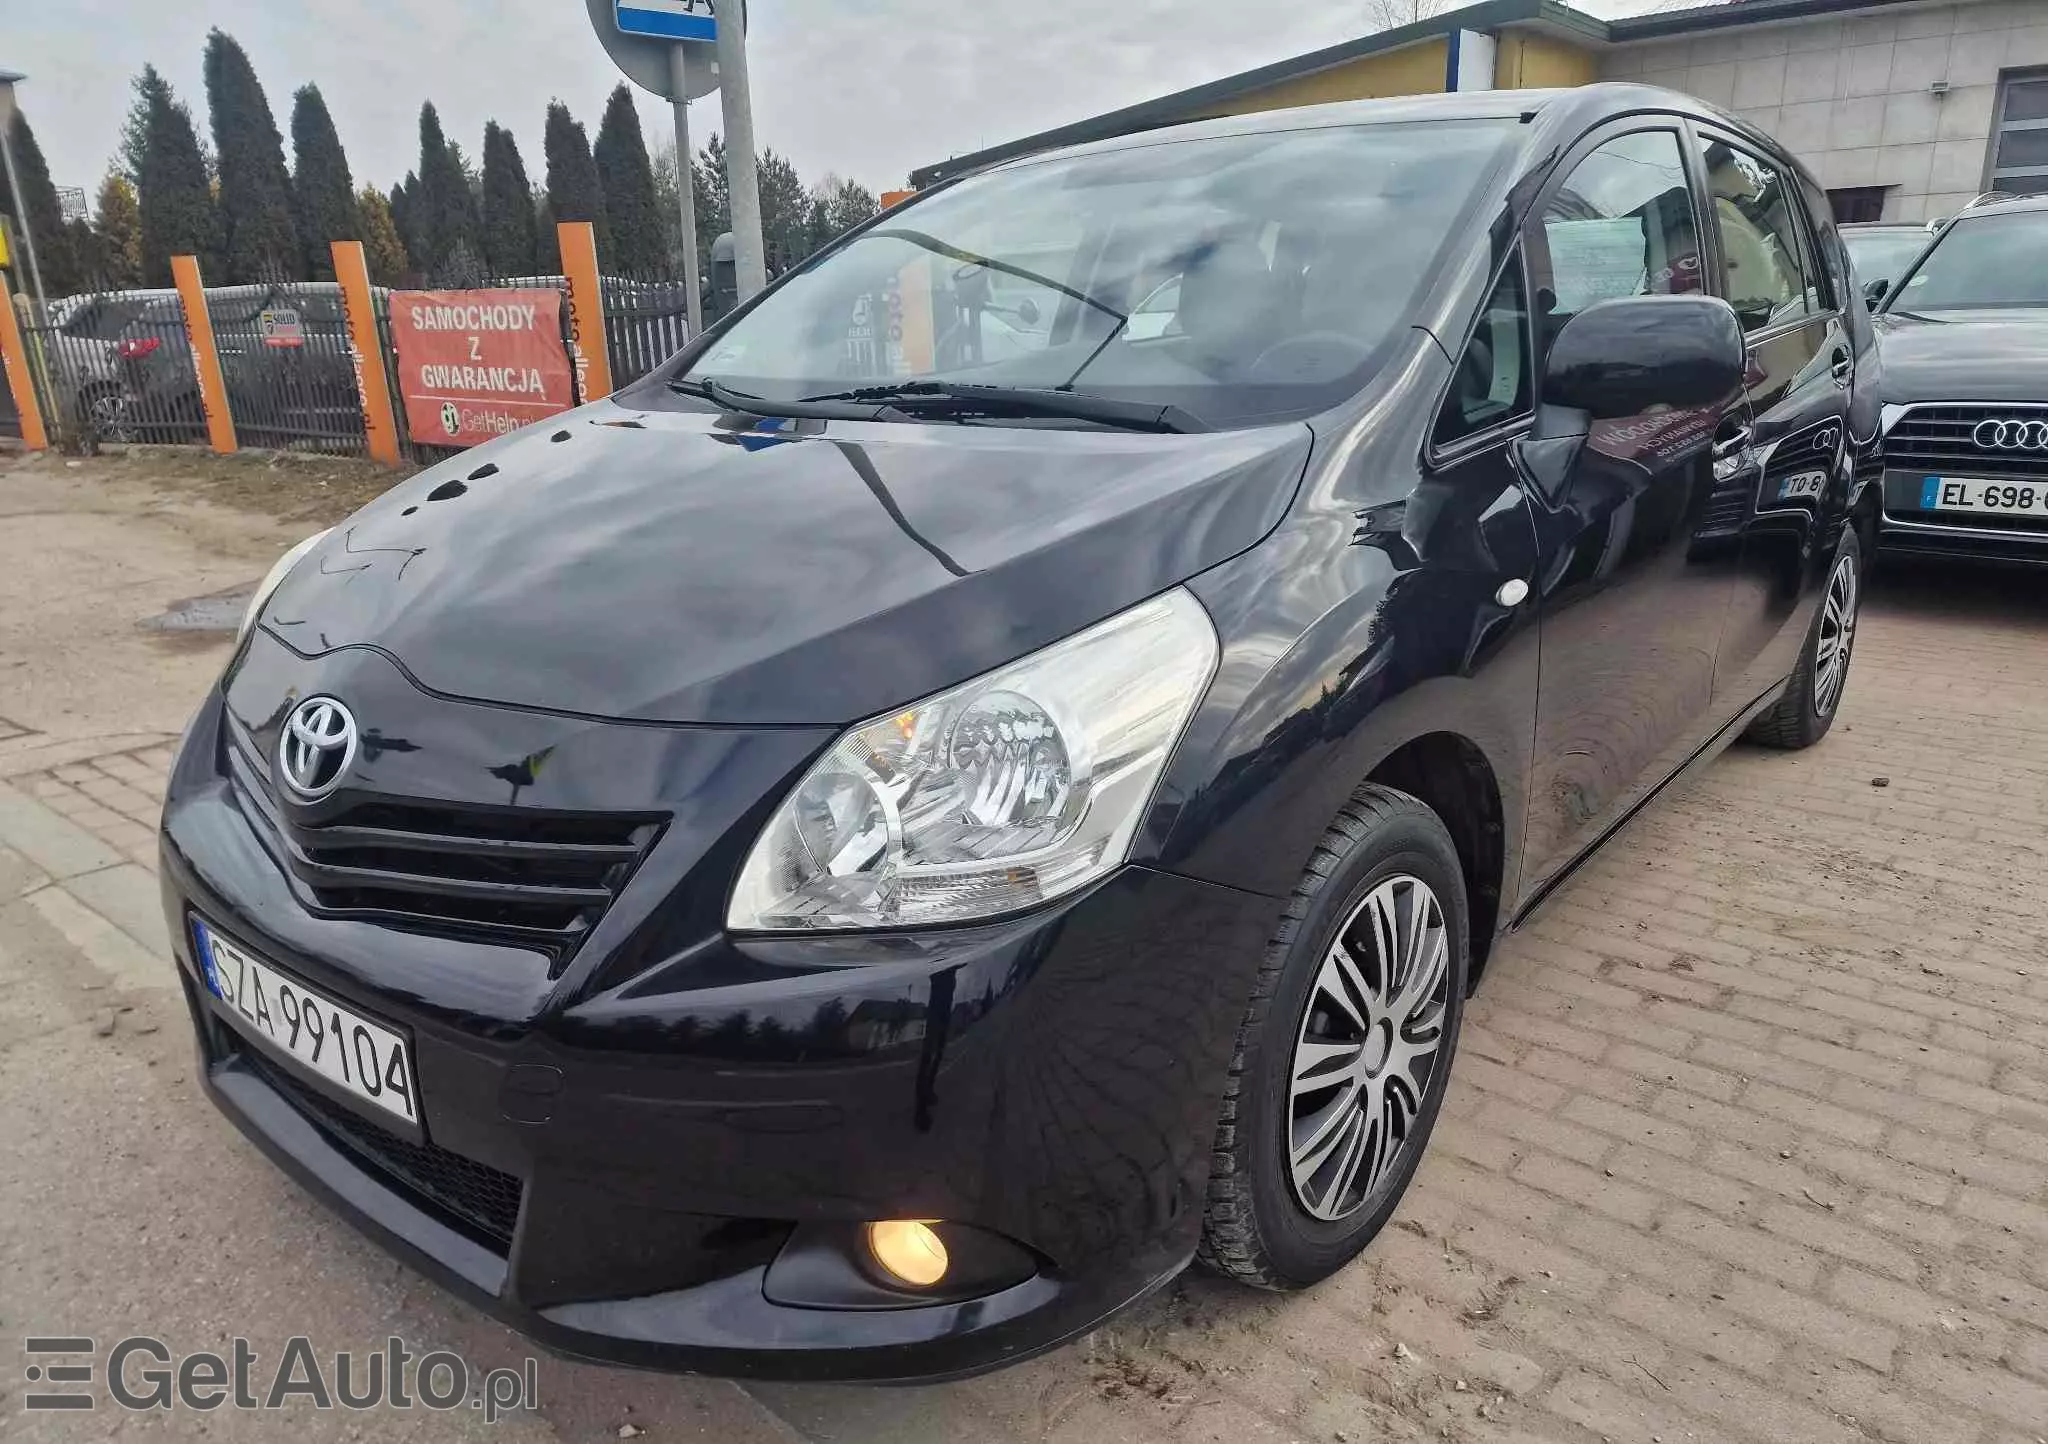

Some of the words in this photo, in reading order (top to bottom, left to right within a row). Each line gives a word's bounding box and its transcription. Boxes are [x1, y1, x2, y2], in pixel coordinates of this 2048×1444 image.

[412, 304, 535, 330] SAMOCHODY
[468, 336, 482, 361] Z
[421, 365, 545, 401] GWARANCJĄ
[1942, 484, 2048, 510] EL-698-
[211, 939, 275, 1037] SZA
[279, 984, 413, 1117] 99104
